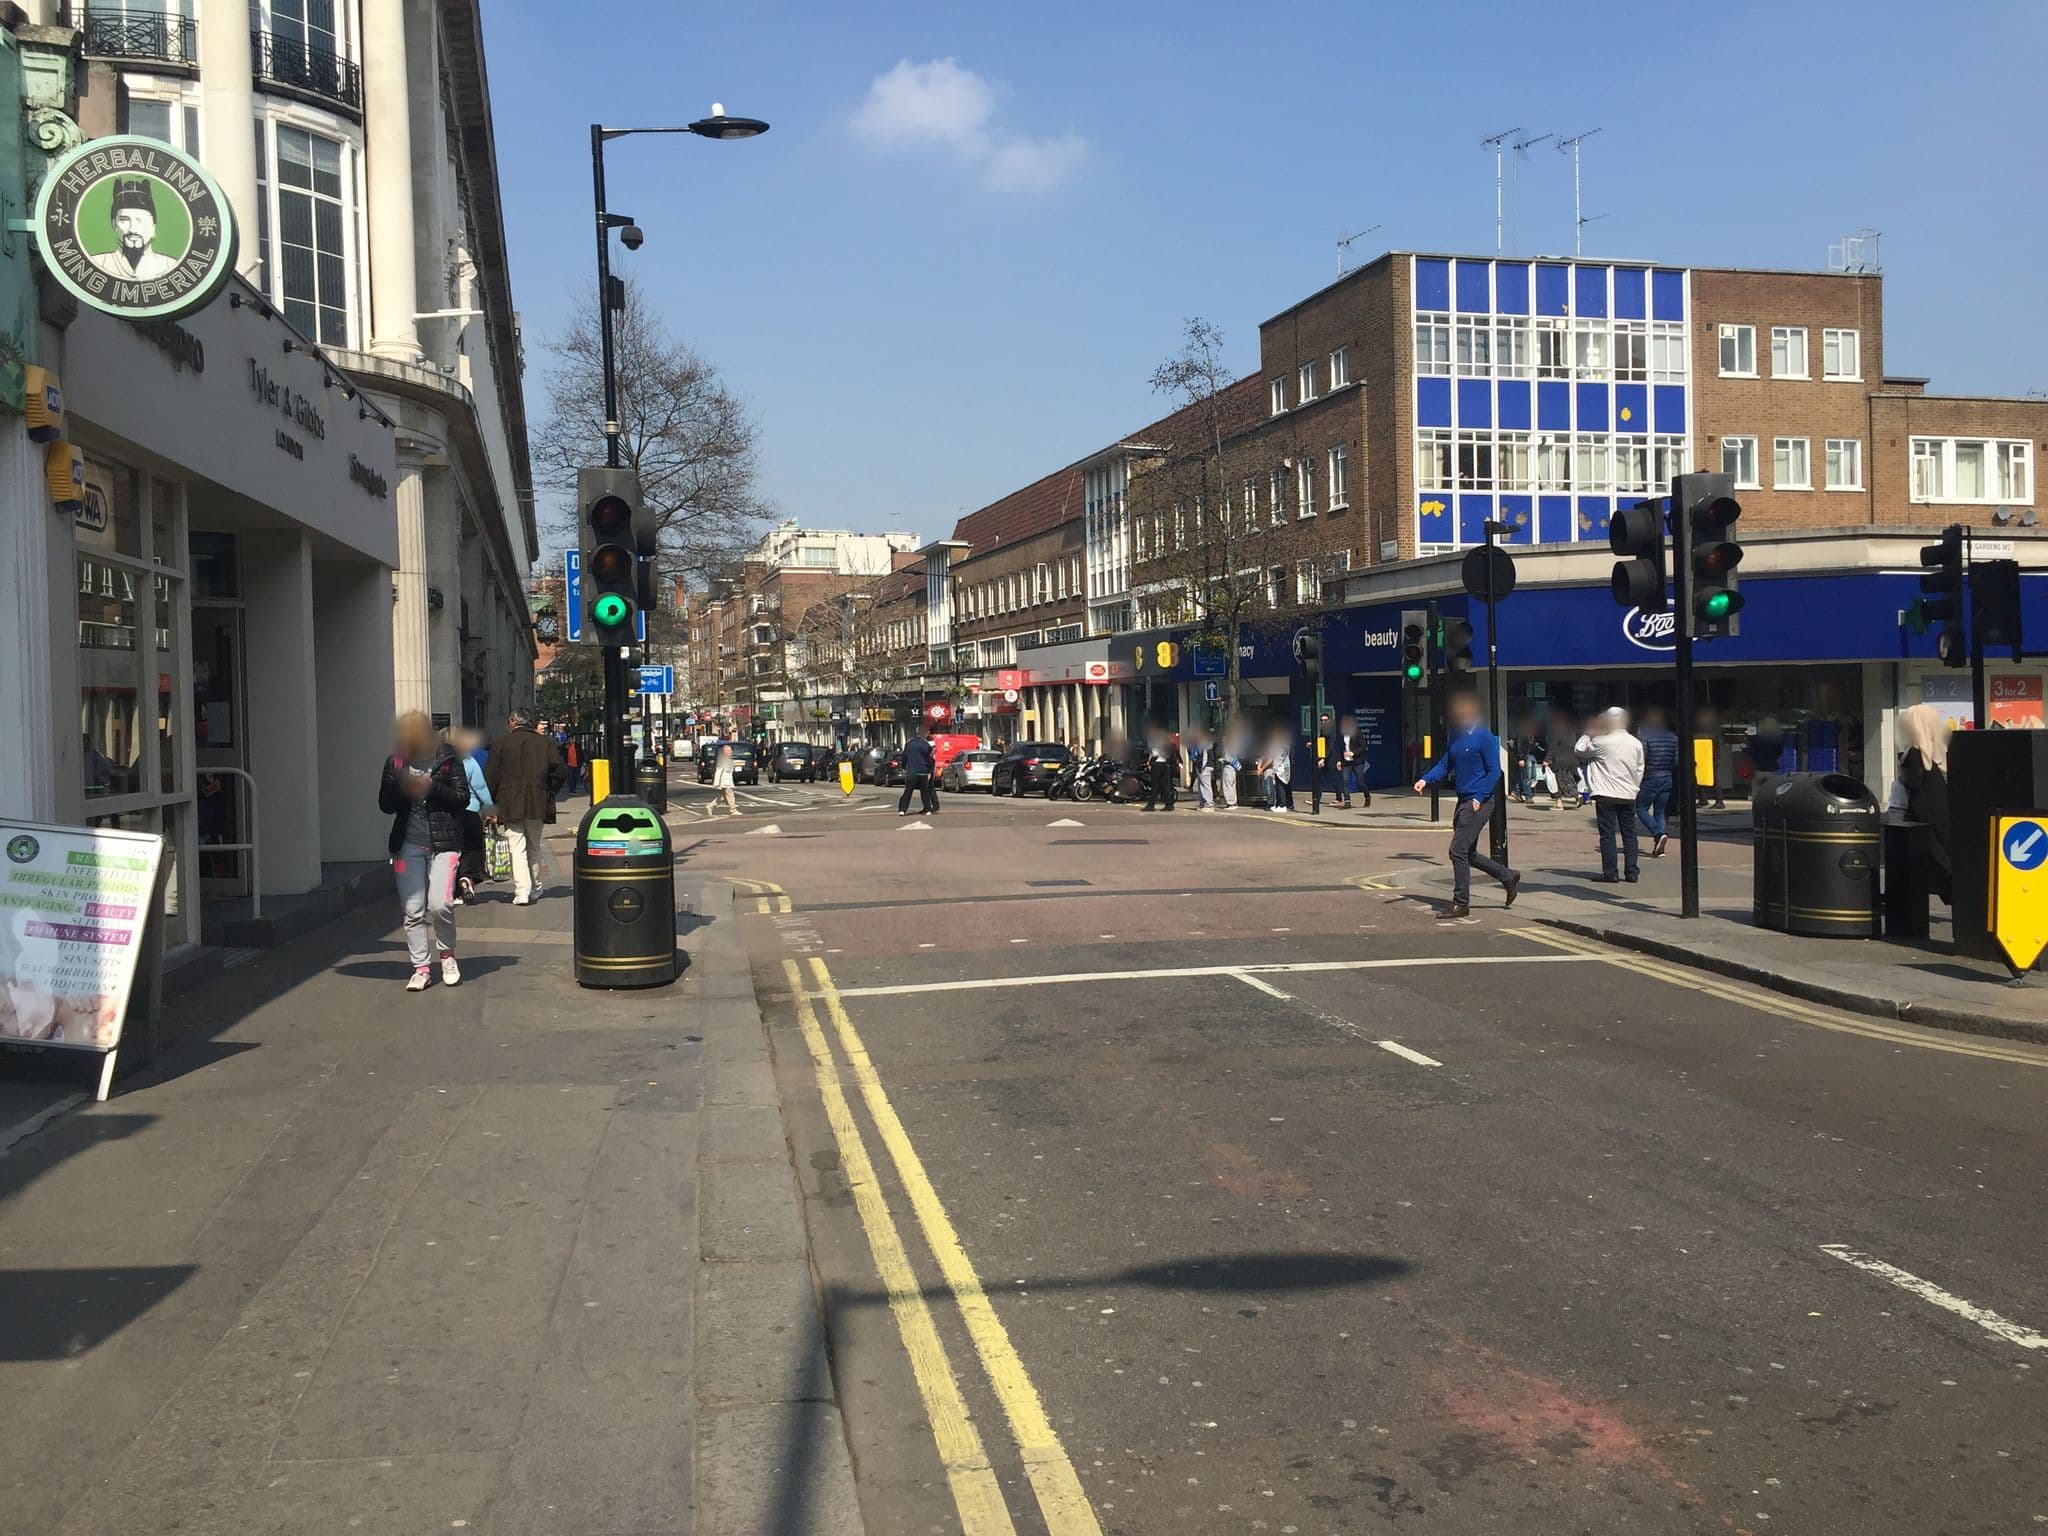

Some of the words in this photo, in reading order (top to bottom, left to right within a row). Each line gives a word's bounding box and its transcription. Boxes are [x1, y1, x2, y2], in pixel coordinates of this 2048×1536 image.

[61, 148, 160, 193] HERBAL
[164, 161, 206, 201] INN
[50, 206, 71, 227] 永
[197, 216, 217, 237] 樂
[54, 238, 107, 293] MING
[112, 248, 214, 303] IMPERIAL
[248, 357, 281, 407] Tyler
[282, 387, 292, 417] &
[296, 394, 325, 440] Gibbs
[1635, 612, 1675, 639] Boo
[1364, 627, 1399, 649] beauty
[1926, 682, 1935, 697] 3
[1936, 688, 1948, 697] for
[1949, 681, 1958, 697] 2
[1994, 680, 2003, 696] 3
[2004, 688, 2016, 697] for
[2017, 680, 2027, 696] 2
[13, 872, 84, 888] IRREGULAR
[86, 880, 139, 893] PERIODS
[41, 888, 69, 899] SKIN
[74, 905, 81, 913] &
[86, 905, 133, 918] BEAUTY
[28, 924, 78, 939] IMMUNE
[81, 930, 128, 943] SYSTEM
[58, 941, 83, 952] HAY
[62, 954, 121, 967] SINUSITIS
